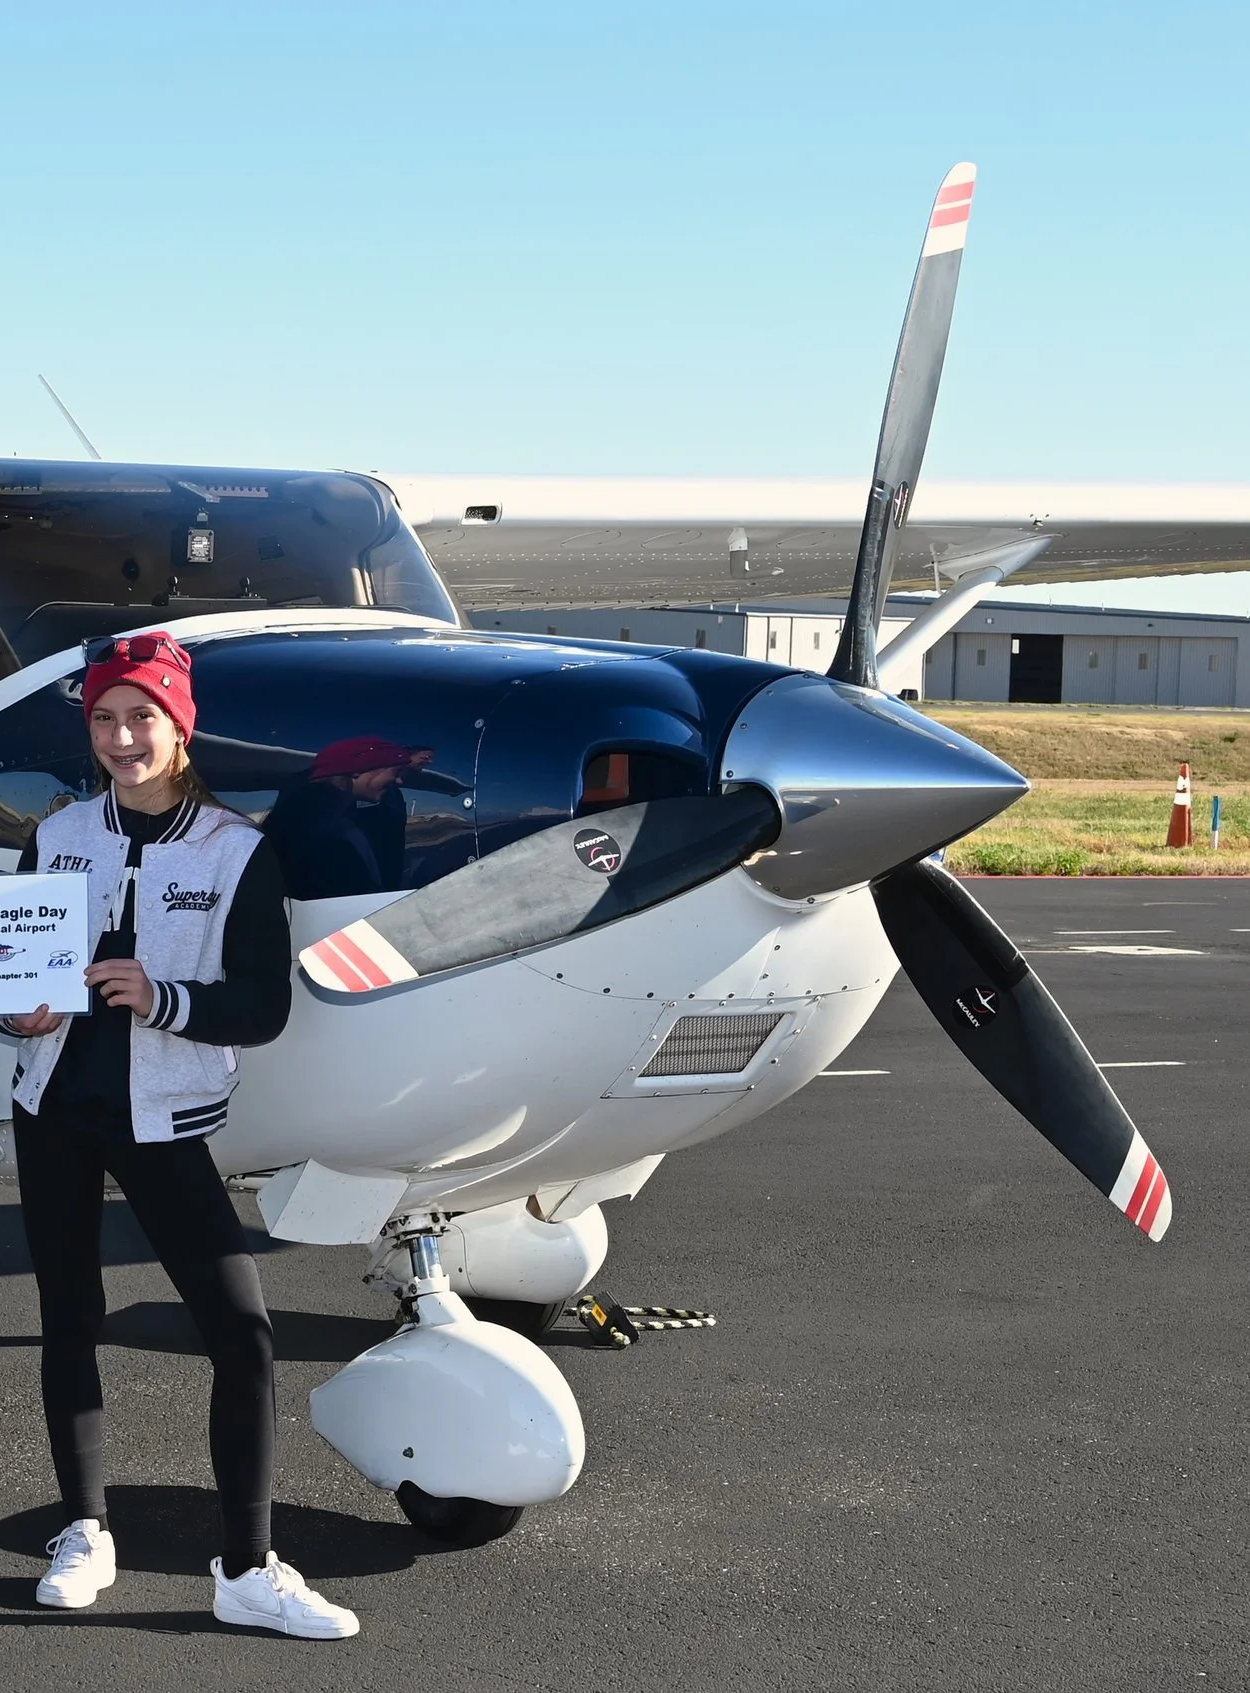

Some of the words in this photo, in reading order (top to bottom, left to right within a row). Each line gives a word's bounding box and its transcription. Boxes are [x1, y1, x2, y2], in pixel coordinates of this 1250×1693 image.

[38, 906, 67, 919] Day
[15, 923, 56, 934] Airport
[47, 958, 72, 967] EAA
